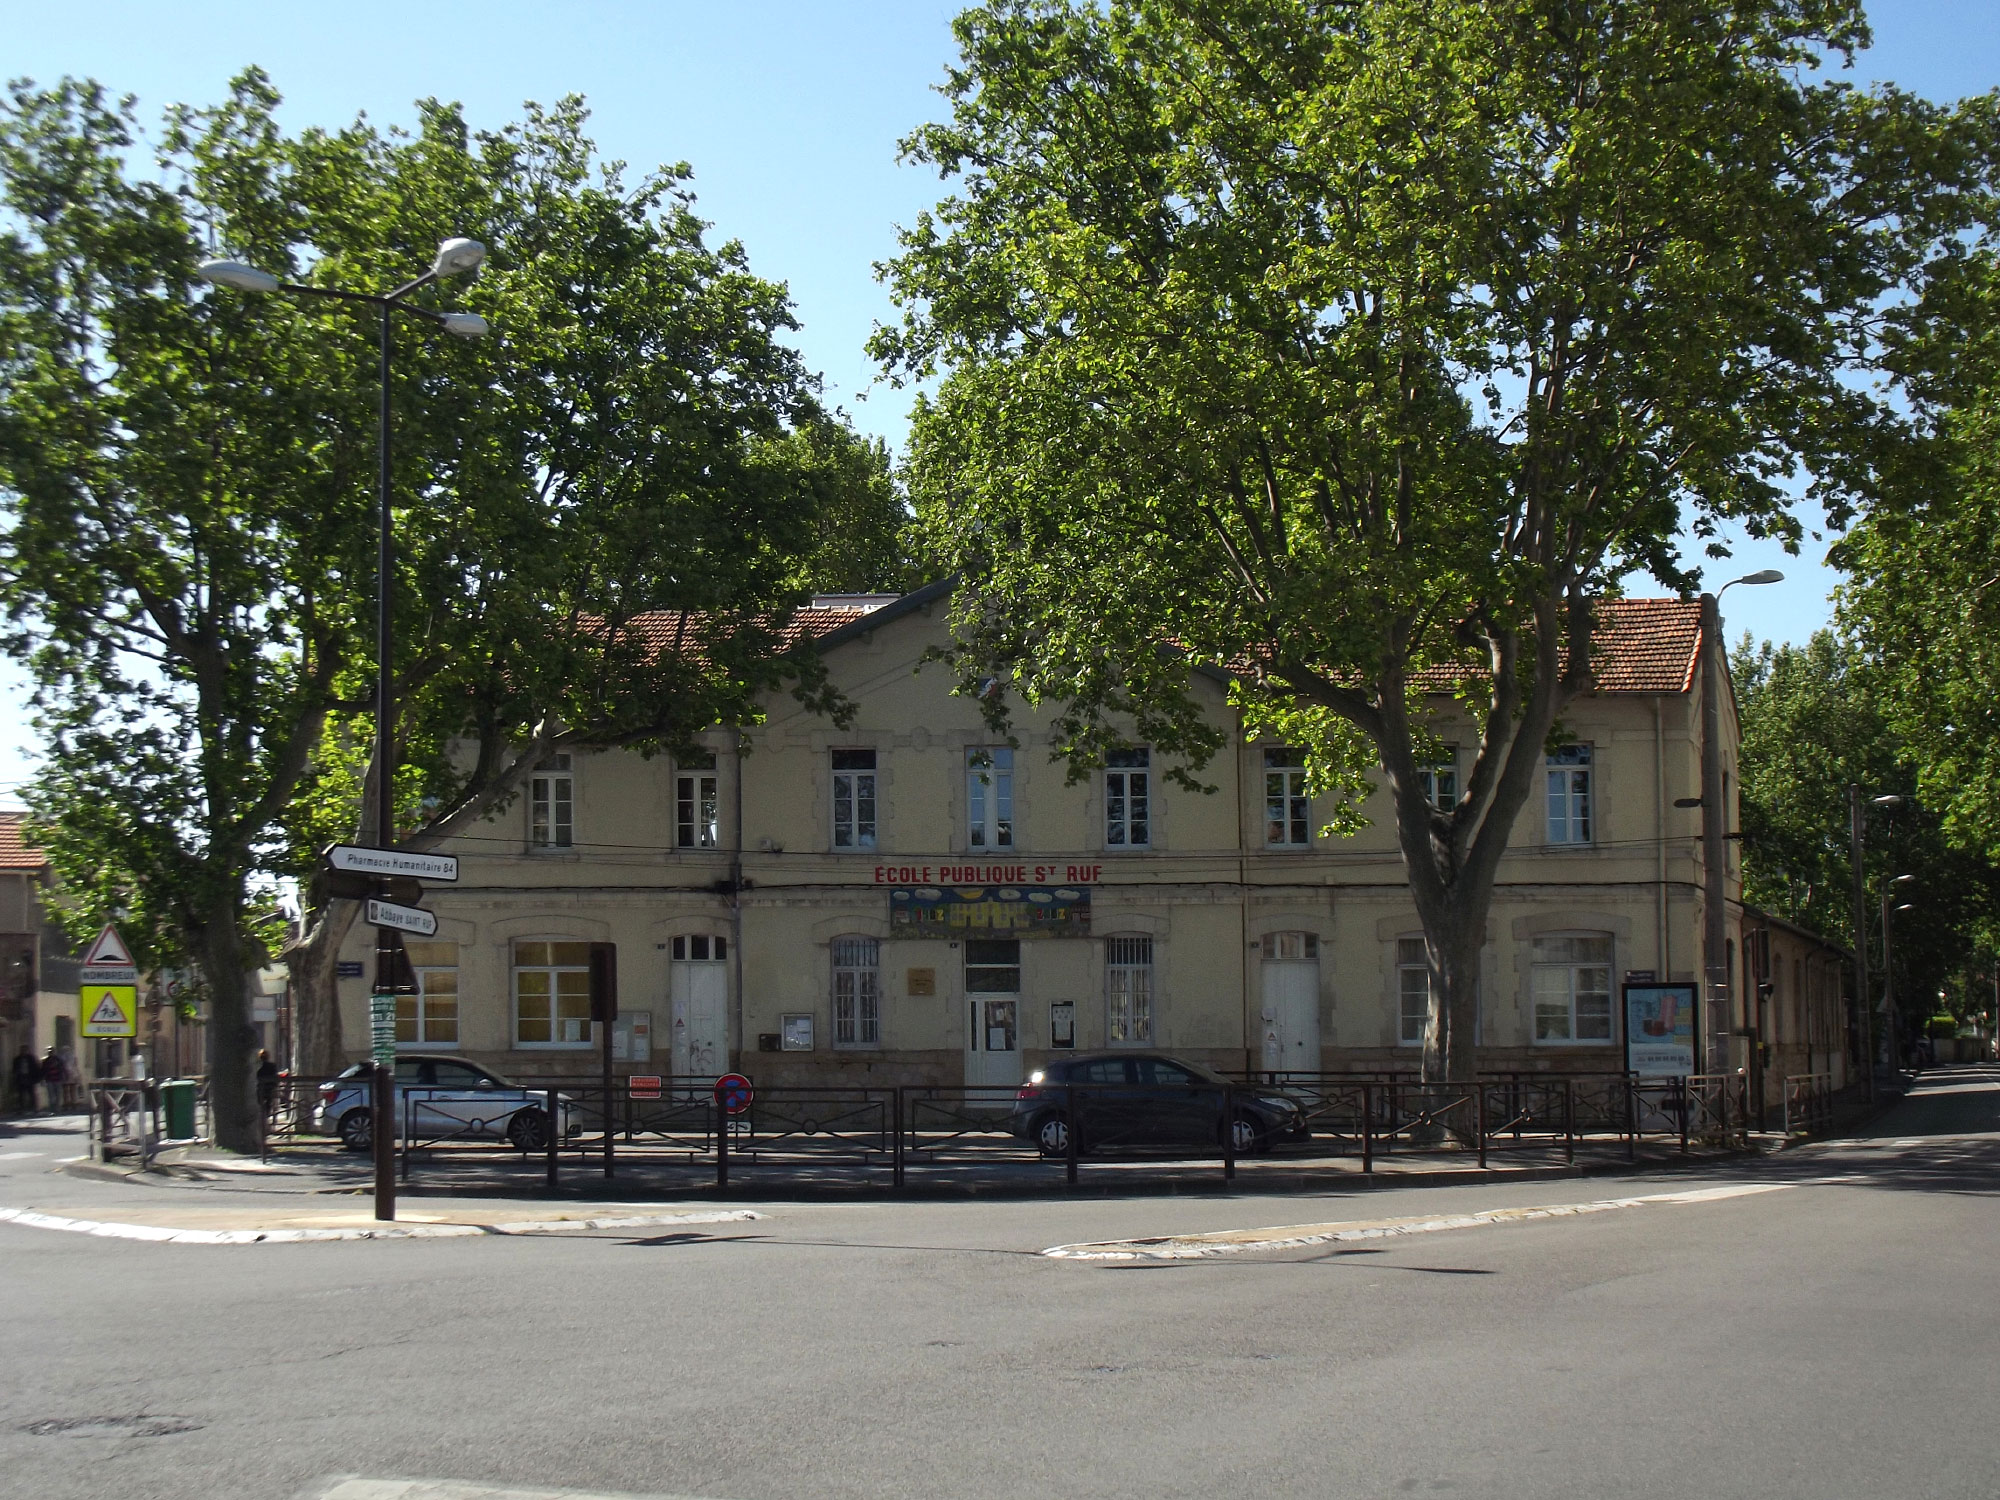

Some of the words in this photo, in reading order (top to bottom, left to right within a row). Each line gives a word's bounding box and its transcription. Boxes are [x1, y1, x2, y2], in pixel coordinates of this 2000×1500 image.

[347, 853, 390, 868] Pharmacie
[392, 858, 441, 872] Humanitaire
[443, 863, 454, 873] 84
[875, 865, 931, 883] ÉCOLE
[940, 866, 1026, 883] PUBLIQUE
[1066, 865, 1102, 882] RUF
[380, 907, 403, 925] Abbaye
[405, 915, 420, 926] SAINT
